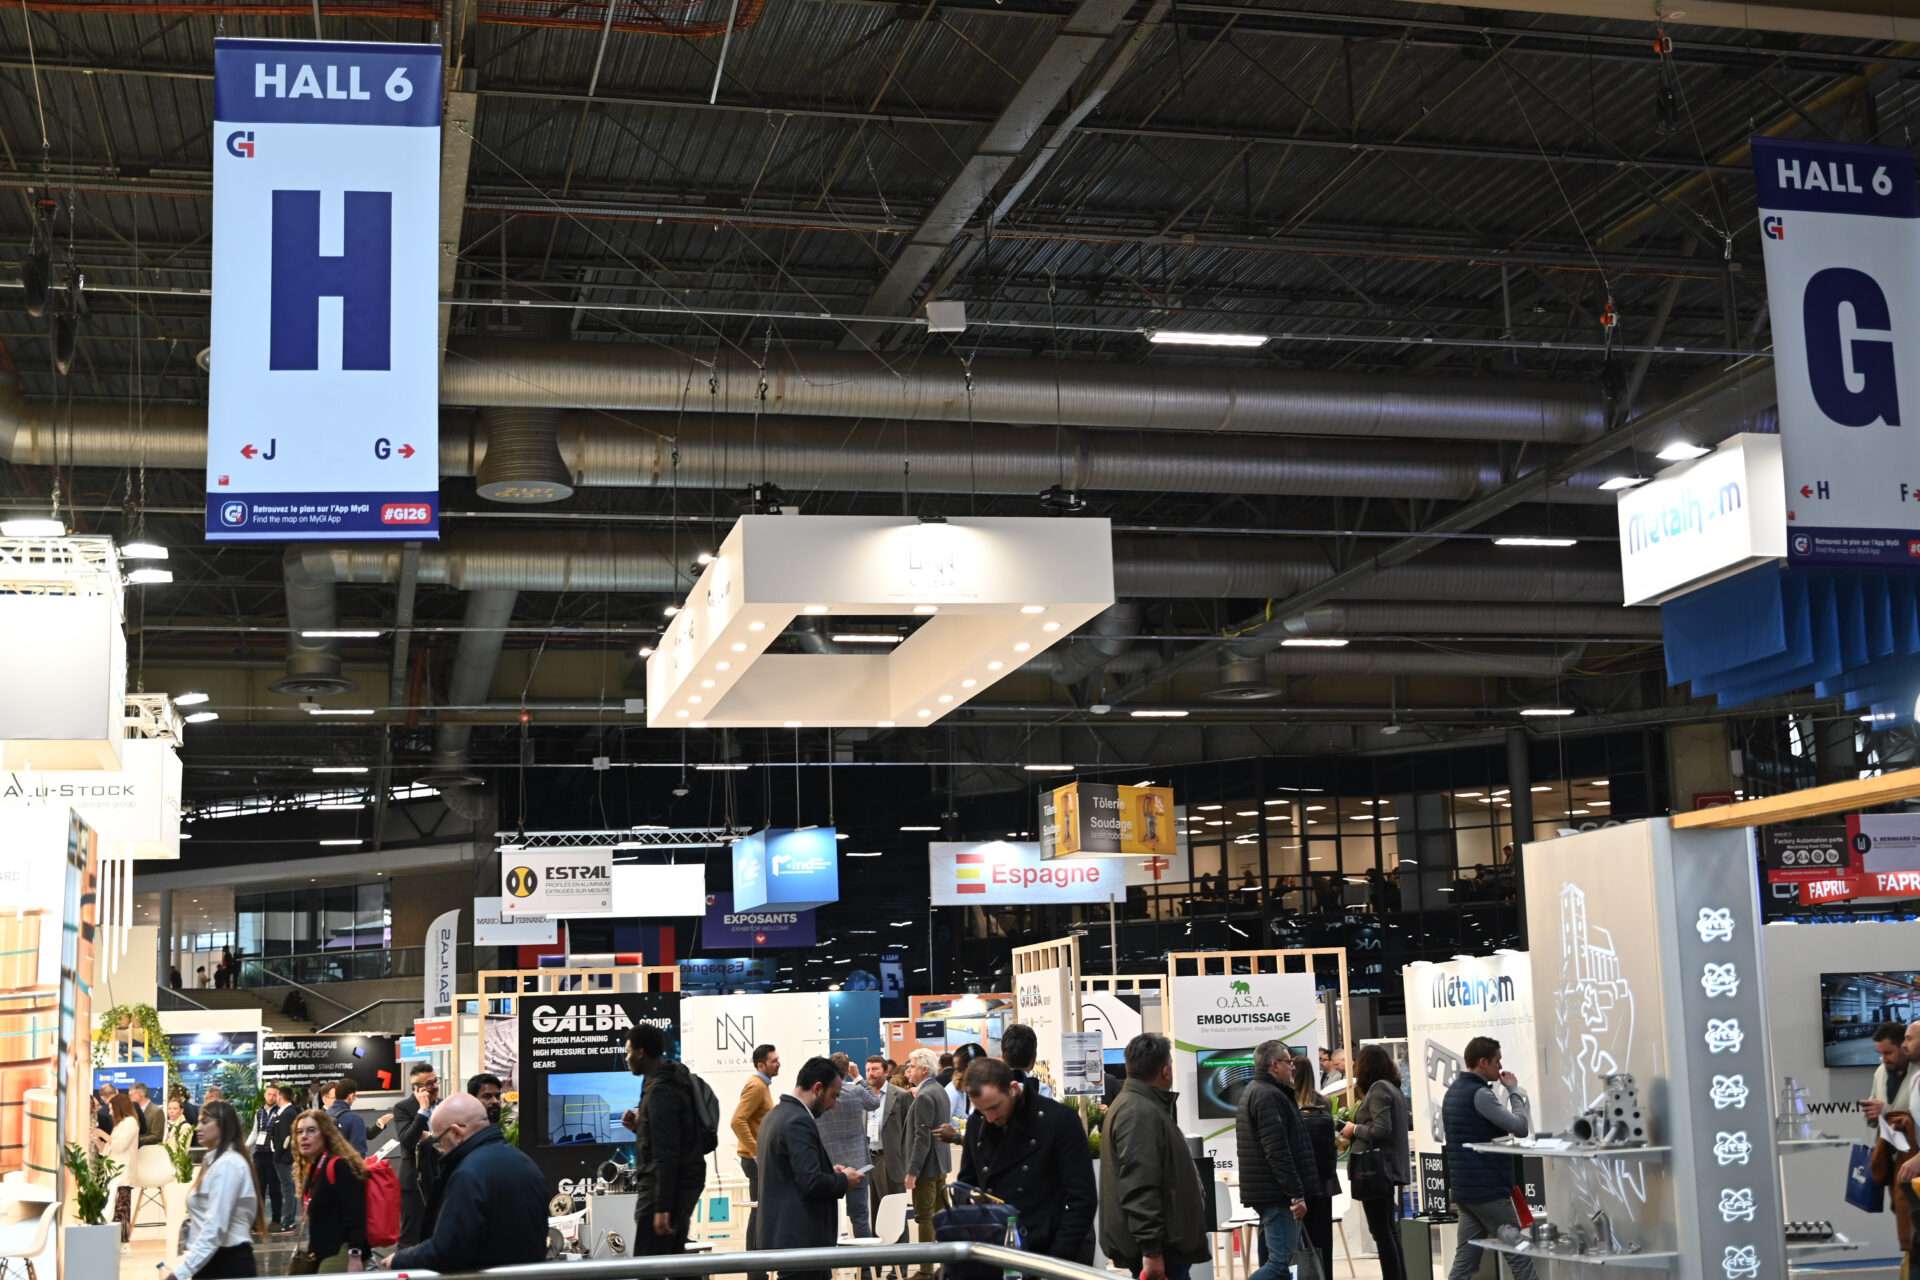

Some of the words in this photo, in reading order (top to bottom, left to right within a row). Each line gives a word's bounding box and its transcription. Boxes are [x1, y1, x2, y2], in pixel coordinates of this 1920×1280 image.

[255, 63, 371, 100] HALL
[384, 67, 413, 102] 6
[1777, 158, 1863, 194] HALL
[1871, 166, 1893, 196] 6
[269, 190, 392, 371] H
[1803, 267, 1901, 427] G
[262, 438, 276, 460] J
[374, 437, 391, 460] G
[1816, 480, 1830, 500] H
[1900, 483, 1909, 502] F
[253, 504, 288, 513] Retrouvez
[290, 504, 298, 513] le
[299, 505, 316, 514] plan
[317, 505, 328, 513] sur
[384, 507, 427, 520] #GI26
[253, 515, 268, 523] Find
[269, 515, 280, 523] the
[281, 516, 298, 525] map
[327, 515, 341, 524] App
[546, 866, 610, 879] ESTRAL
[992, 862, 1100, 888] Espagne
[1808, 880, 1850, 899] FAPRIL
[723, 913, 798, 925] EXPOSANTS
[532, 1003, 634, 1033] GALBA
[1197, 1012, 1291, 1025] EMBOUTISSAGE
[296, 1040, 337, 1050] TECHNIQUE
[532, 1036, 569, 1045] PRECISION
[570, 1035, 609, 1043] MACHINING
[273, 1050, 310, 1059] TECHNICAL
[312, 1049, 330, 1058] DESK
[532, 1049, 549, 1057] HIGH
[550, 1047, 587, 1056] PRESSURE
[587, 1047, 599, 1055] DIE
[532, 1060, 556, 1069] GEARS
[1208, 1149, 1217, 1157] 17
